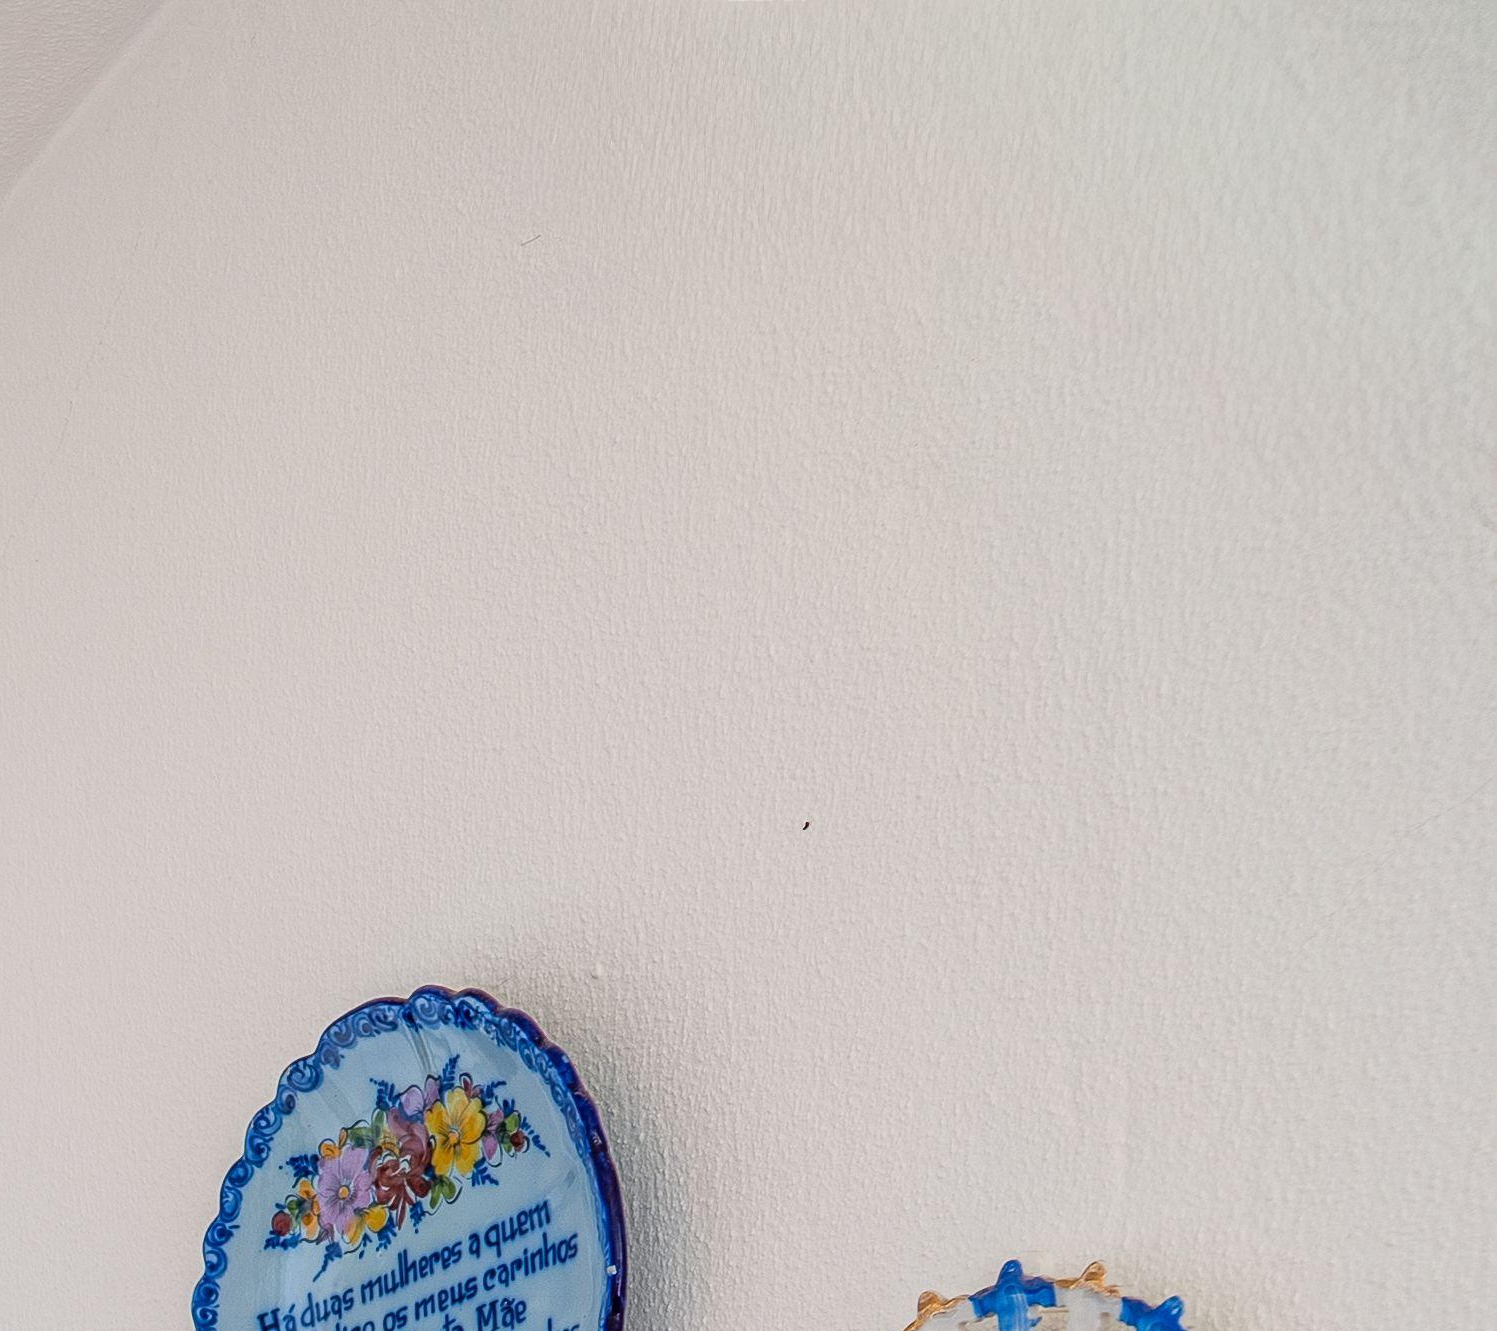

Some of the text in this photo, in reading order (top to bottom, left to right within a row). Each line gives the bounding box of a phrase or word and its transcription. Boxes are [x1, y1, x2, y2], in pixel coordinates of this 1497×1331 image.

[300, 1292, 355, 1328] duas
[360, 1240, 463, 1305] mulheres
[468, 1231, 482, 1259] a
[483, 1200, 552, 1258] quem
[414, 1276, 478, 1321] meus
[482, 1231, 579, 1292] carinhos
